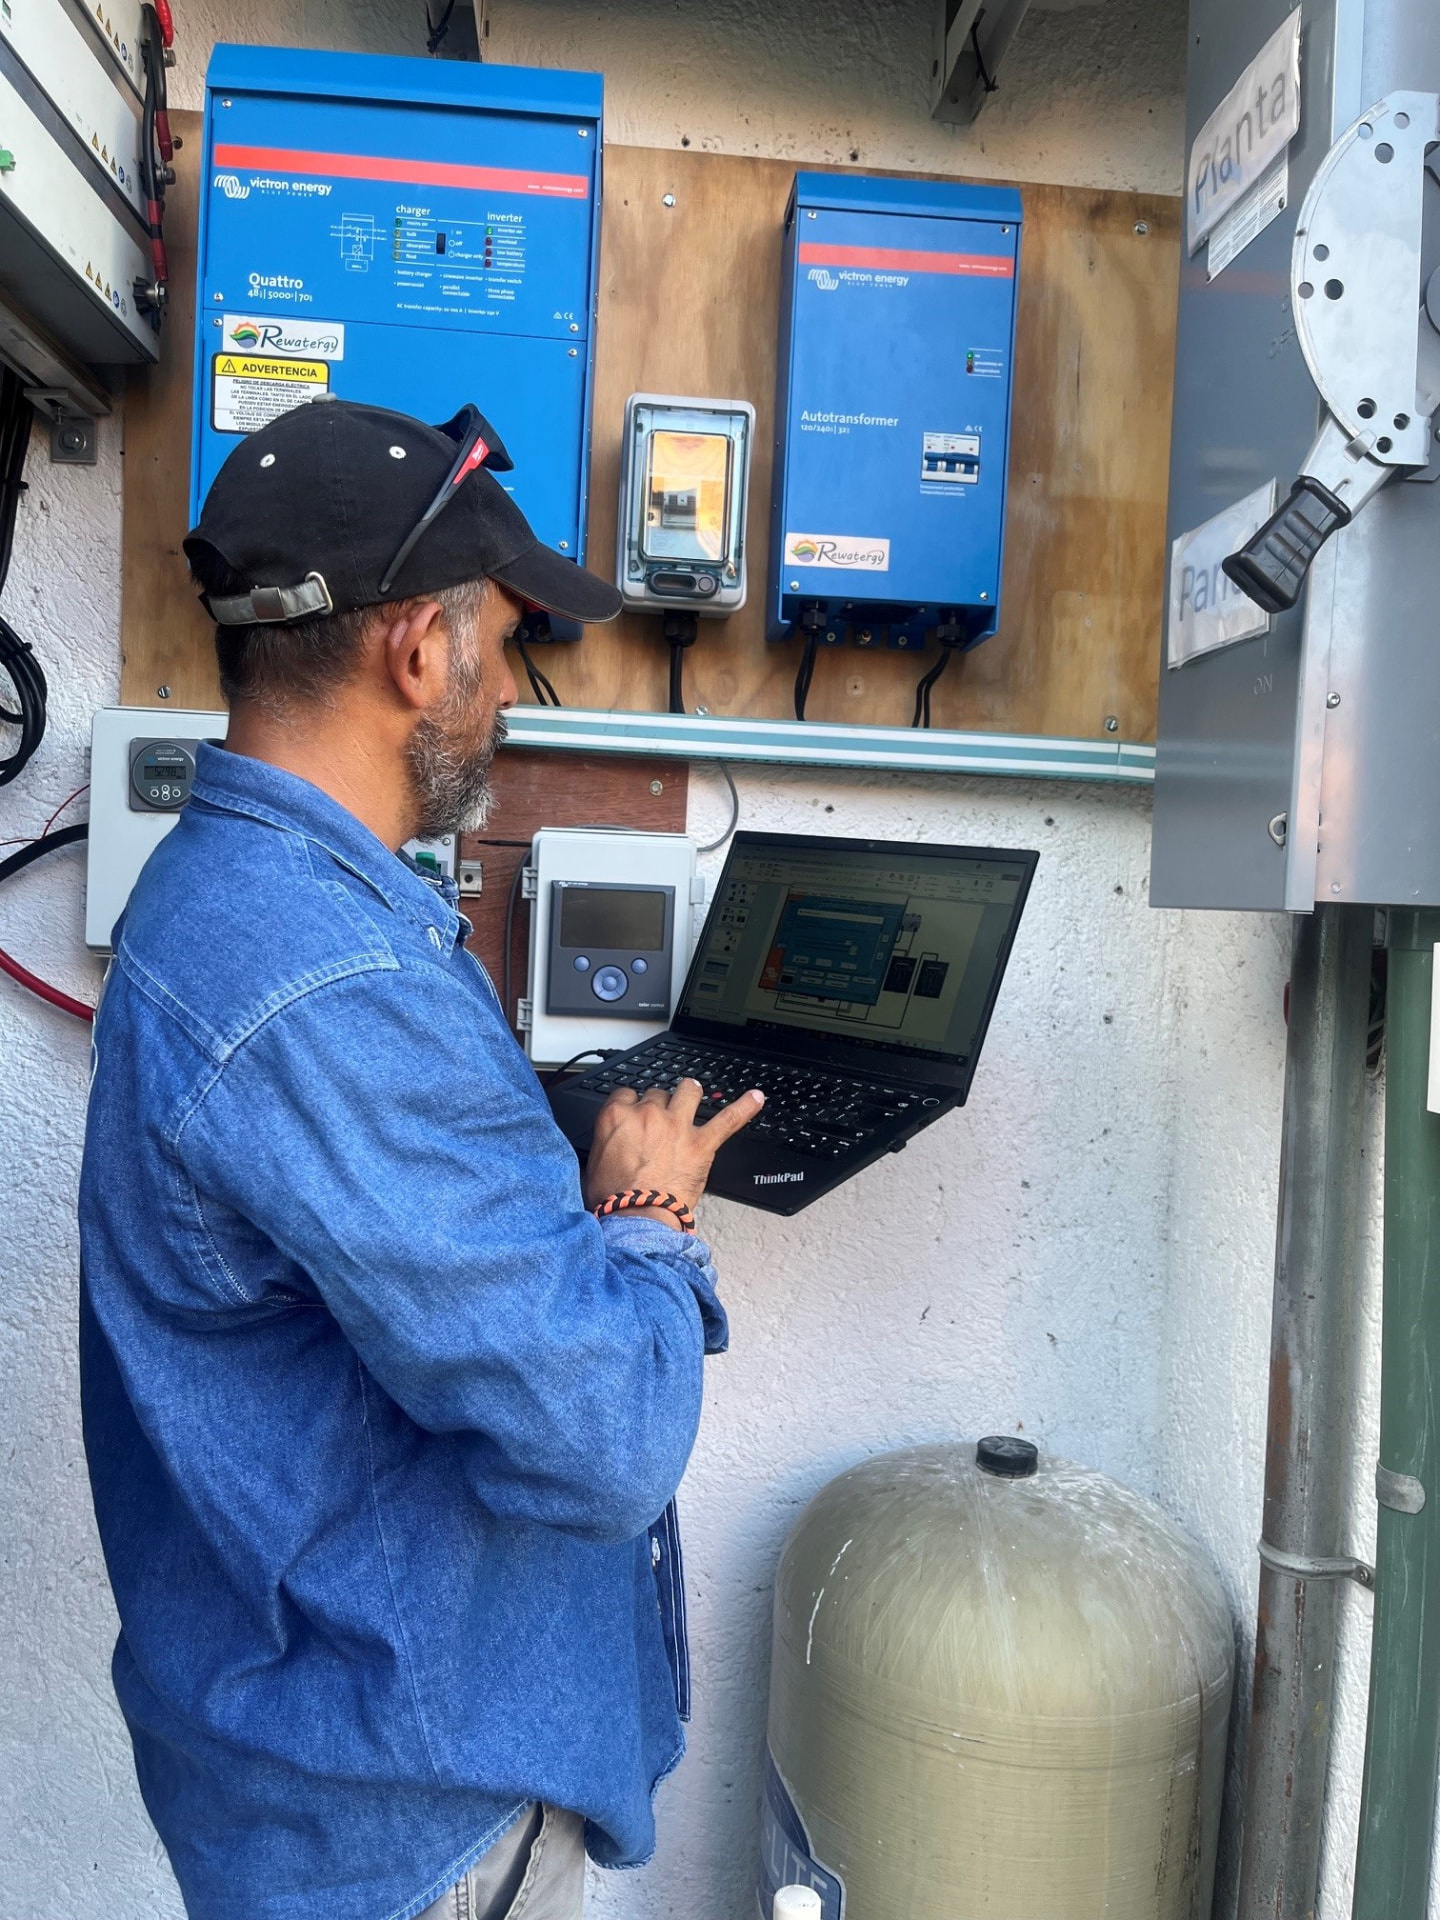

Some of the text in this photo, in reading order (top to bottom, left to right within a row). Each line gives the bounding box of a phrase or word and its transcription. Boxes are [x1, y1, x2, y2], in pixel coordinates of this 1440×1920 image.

[1195, 71, 1285, 215] Planta
[250, 176, 333, 196] victron energy
[396, 204, 431, 217] charger
[487, 211, 523, 223] inverter
[249, 272, 304, 289] Quattro
[839, 270, 909, 287] victron energy
[258, 324, 339, 353] Rewatergy
[242, 363, 318, 378] ADVERTENCIA
[801, 410, 899, 427] Autotransformer
[816, 541, 885, 565] Rewatergy
[753, 1171, 804, 1185] ThinkPad
